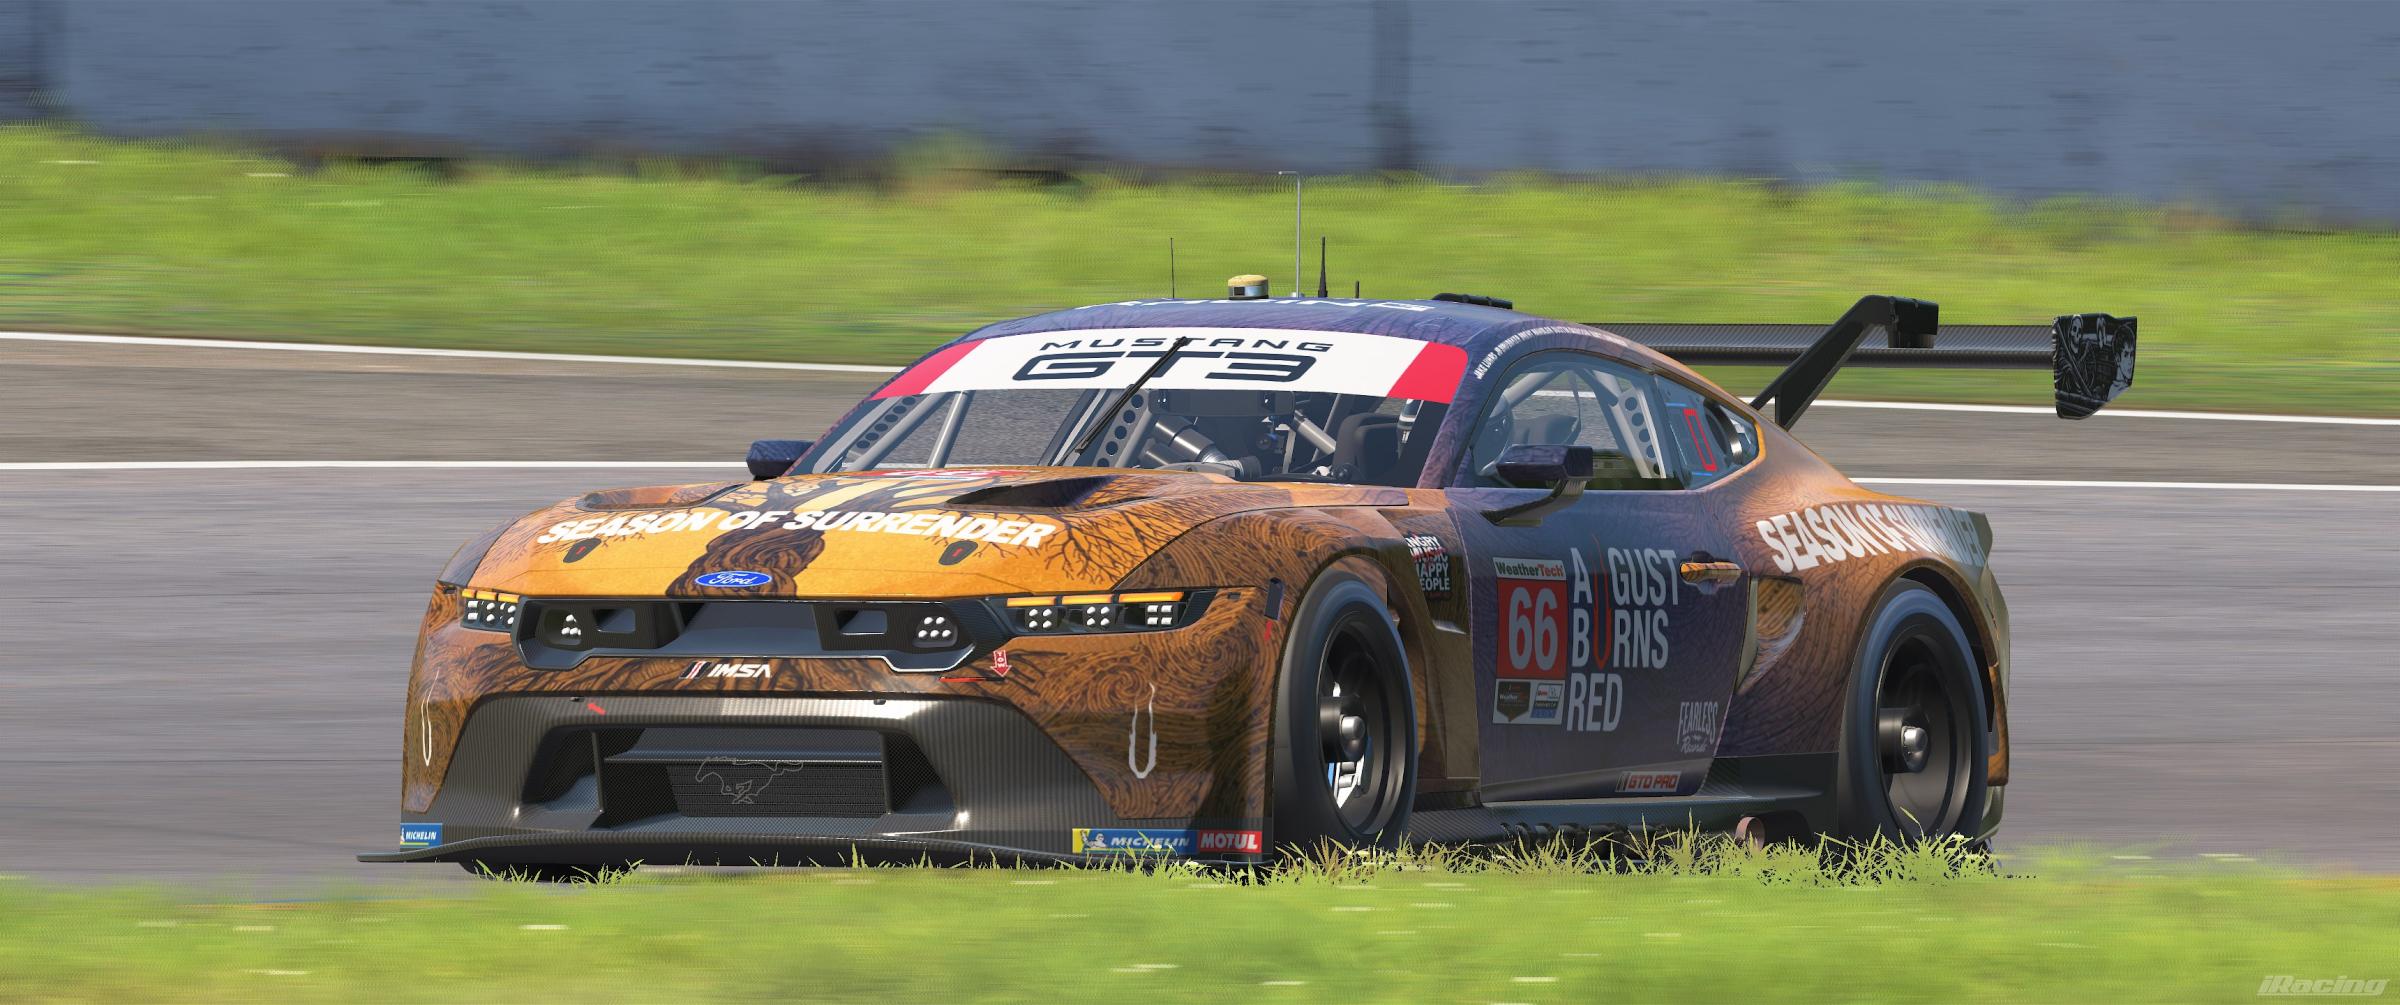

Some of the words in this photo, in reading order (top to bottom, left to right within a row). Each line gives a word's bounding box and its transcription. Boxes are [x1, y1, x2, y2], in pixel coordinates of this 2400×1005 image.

[1040, 337, 1335, 352] MUSTANG
[1012, 350, 1317, 383] GT3
[537, 511, 721, 544] SEASON
[718, 510, 791, 531] OF
[782, 510, 1056, 549] SURRENDER
[1756, 504, 1890, 574] SEASON
[1855, 504, 1917, 552] OF
[1495, 561, 1564, 577] WeatherTech
[708, 573, 759, 585] Ford
[1508, 586, 1559, 671] 66
[1571, 608, 1669, 670] BURNS
[996, 651, 1005, 667] TOW
[706, 663, 771, 678] IMSA
[1566, 672, 1623, 732] RED
[1676, 701, 1719, 745] FEARLESS
[1627, 775, 1653, 789] GTD
[1652, 775, 1680, 789] PRO
[405, 831, 438, 841] MICHELIN
[1110, 836, 1191, 847] MICHELIN
[1200, 832, 1259, 850] MOTUL
